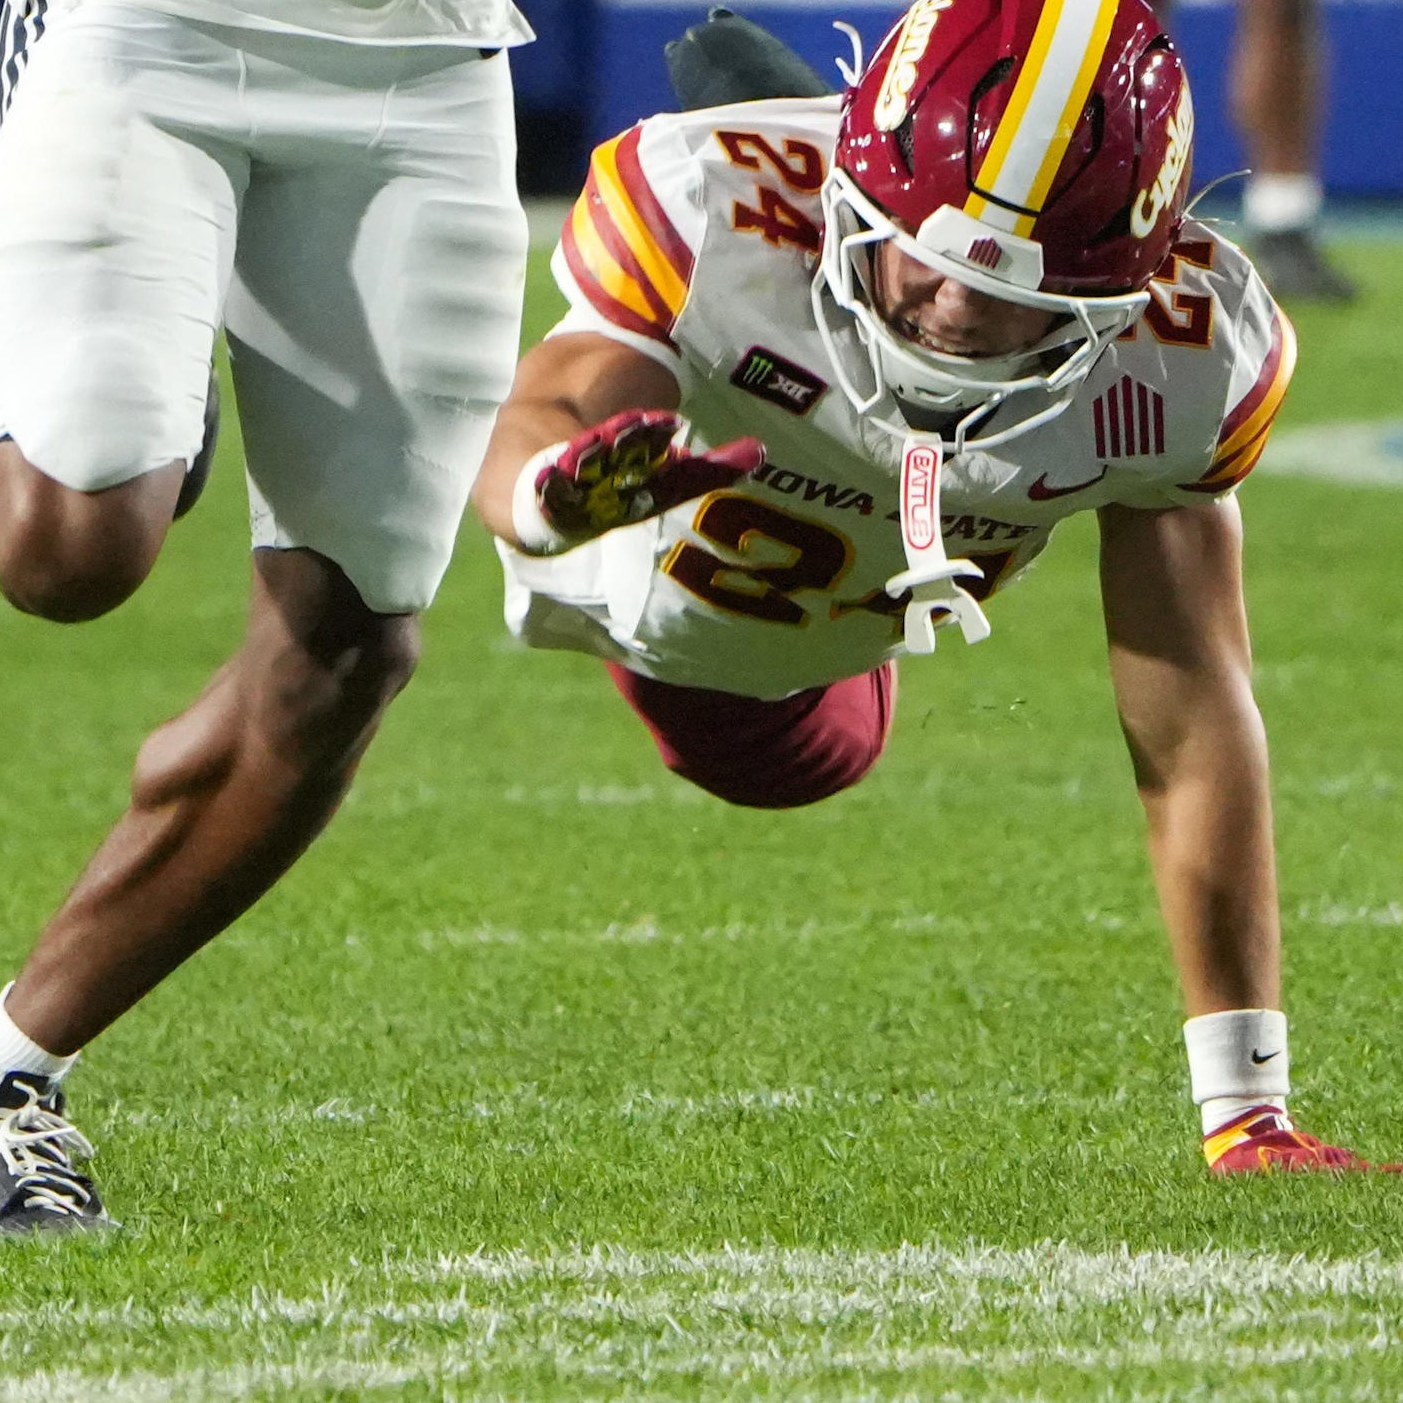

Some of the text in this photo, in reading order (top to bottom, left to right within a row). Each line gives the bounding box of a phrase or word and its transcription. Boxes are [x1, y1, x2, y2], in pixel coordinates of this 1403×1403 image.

[711, 129, 826, 256] 24
[750, 462, 875, 516] IOWA
[911, 455, 931, 537] BATTLE
